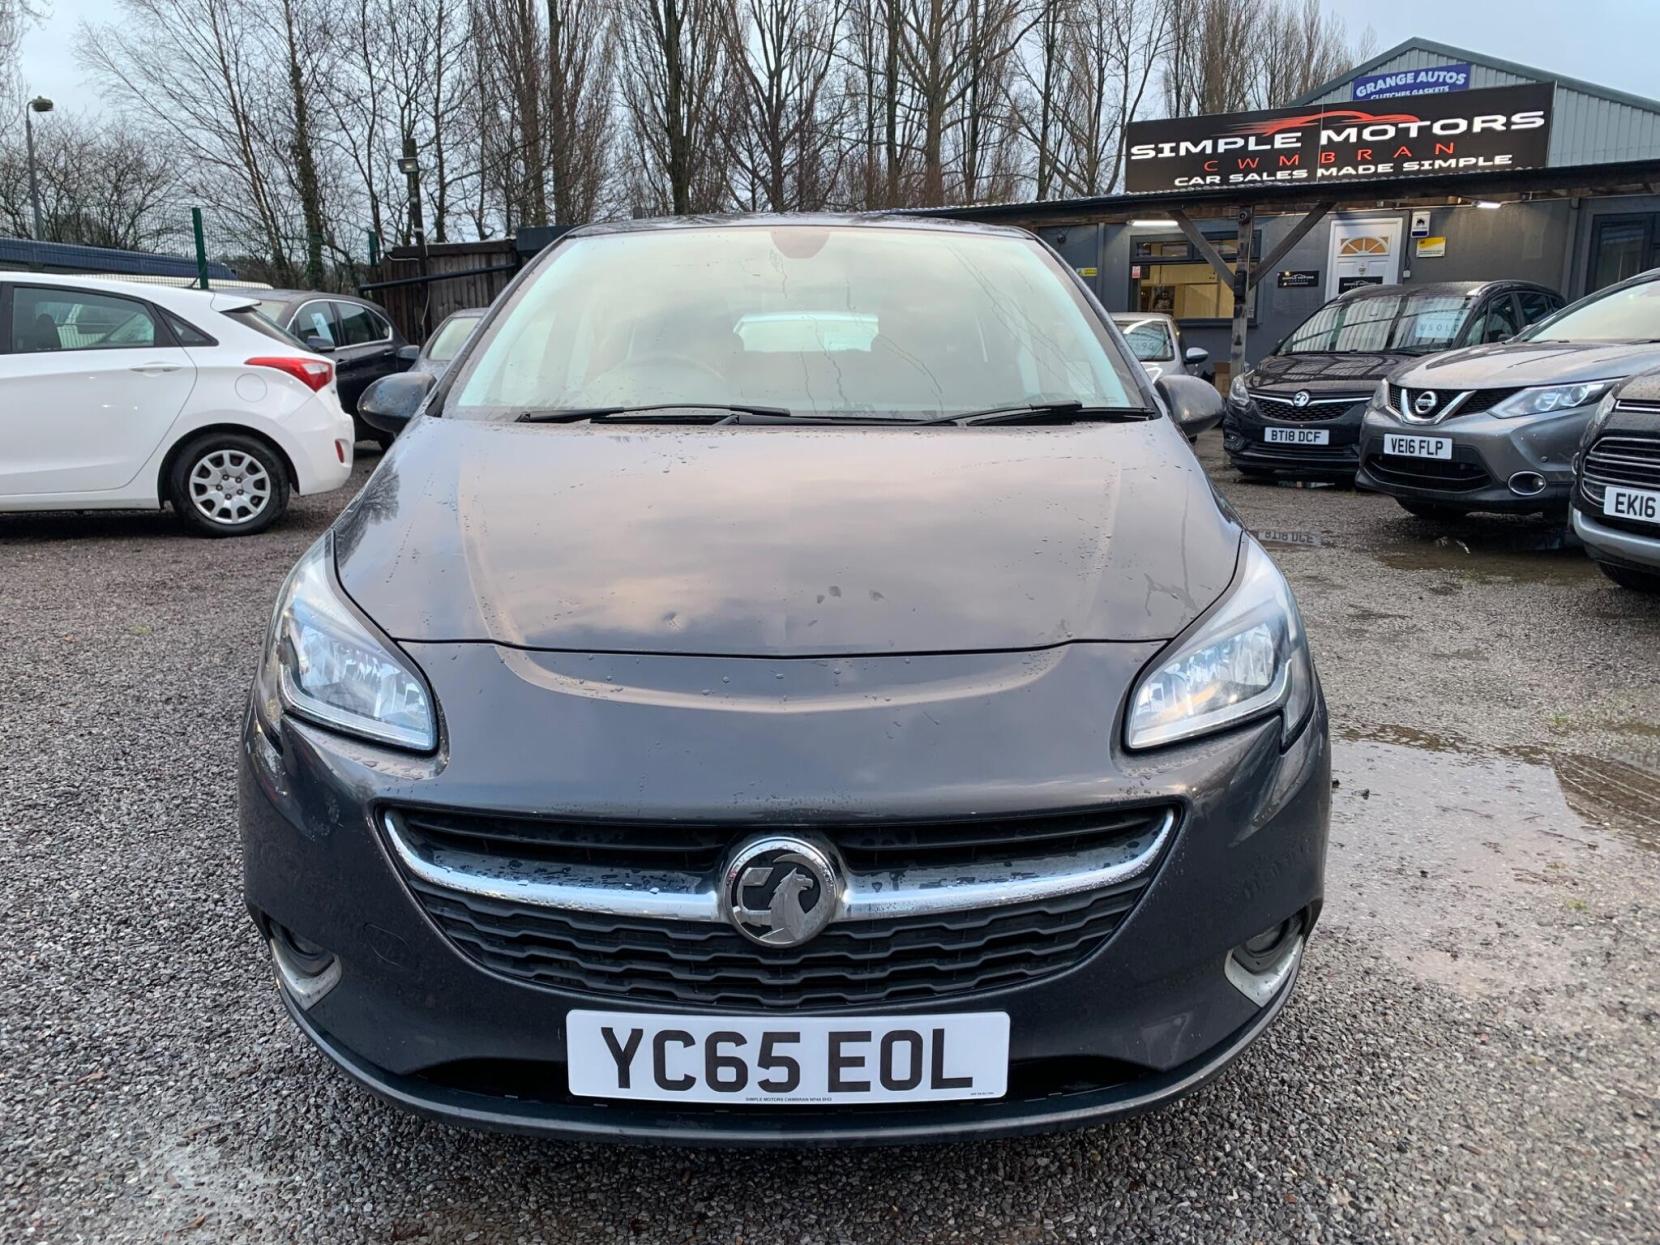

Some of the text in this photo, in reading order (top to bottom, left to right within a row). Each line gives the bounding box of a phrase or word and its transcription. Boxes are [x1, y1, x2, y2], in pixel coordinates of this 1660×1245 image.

[1356, 71, 1467, 97] GRANGE AUTOS
[1130, 111, 1545, 160] SIMPLE MOTORS
[1174, 155, 1513, 187] CAR SALES MADE SIMPLE
[1271, 429, 1321, 443] BT18 DCF
[1391, 437, 1443, 456] VE16 FLP
[1615, 492, 1656, 518] EK16
[601, 1027, 973, 1093] YC65 EOL
